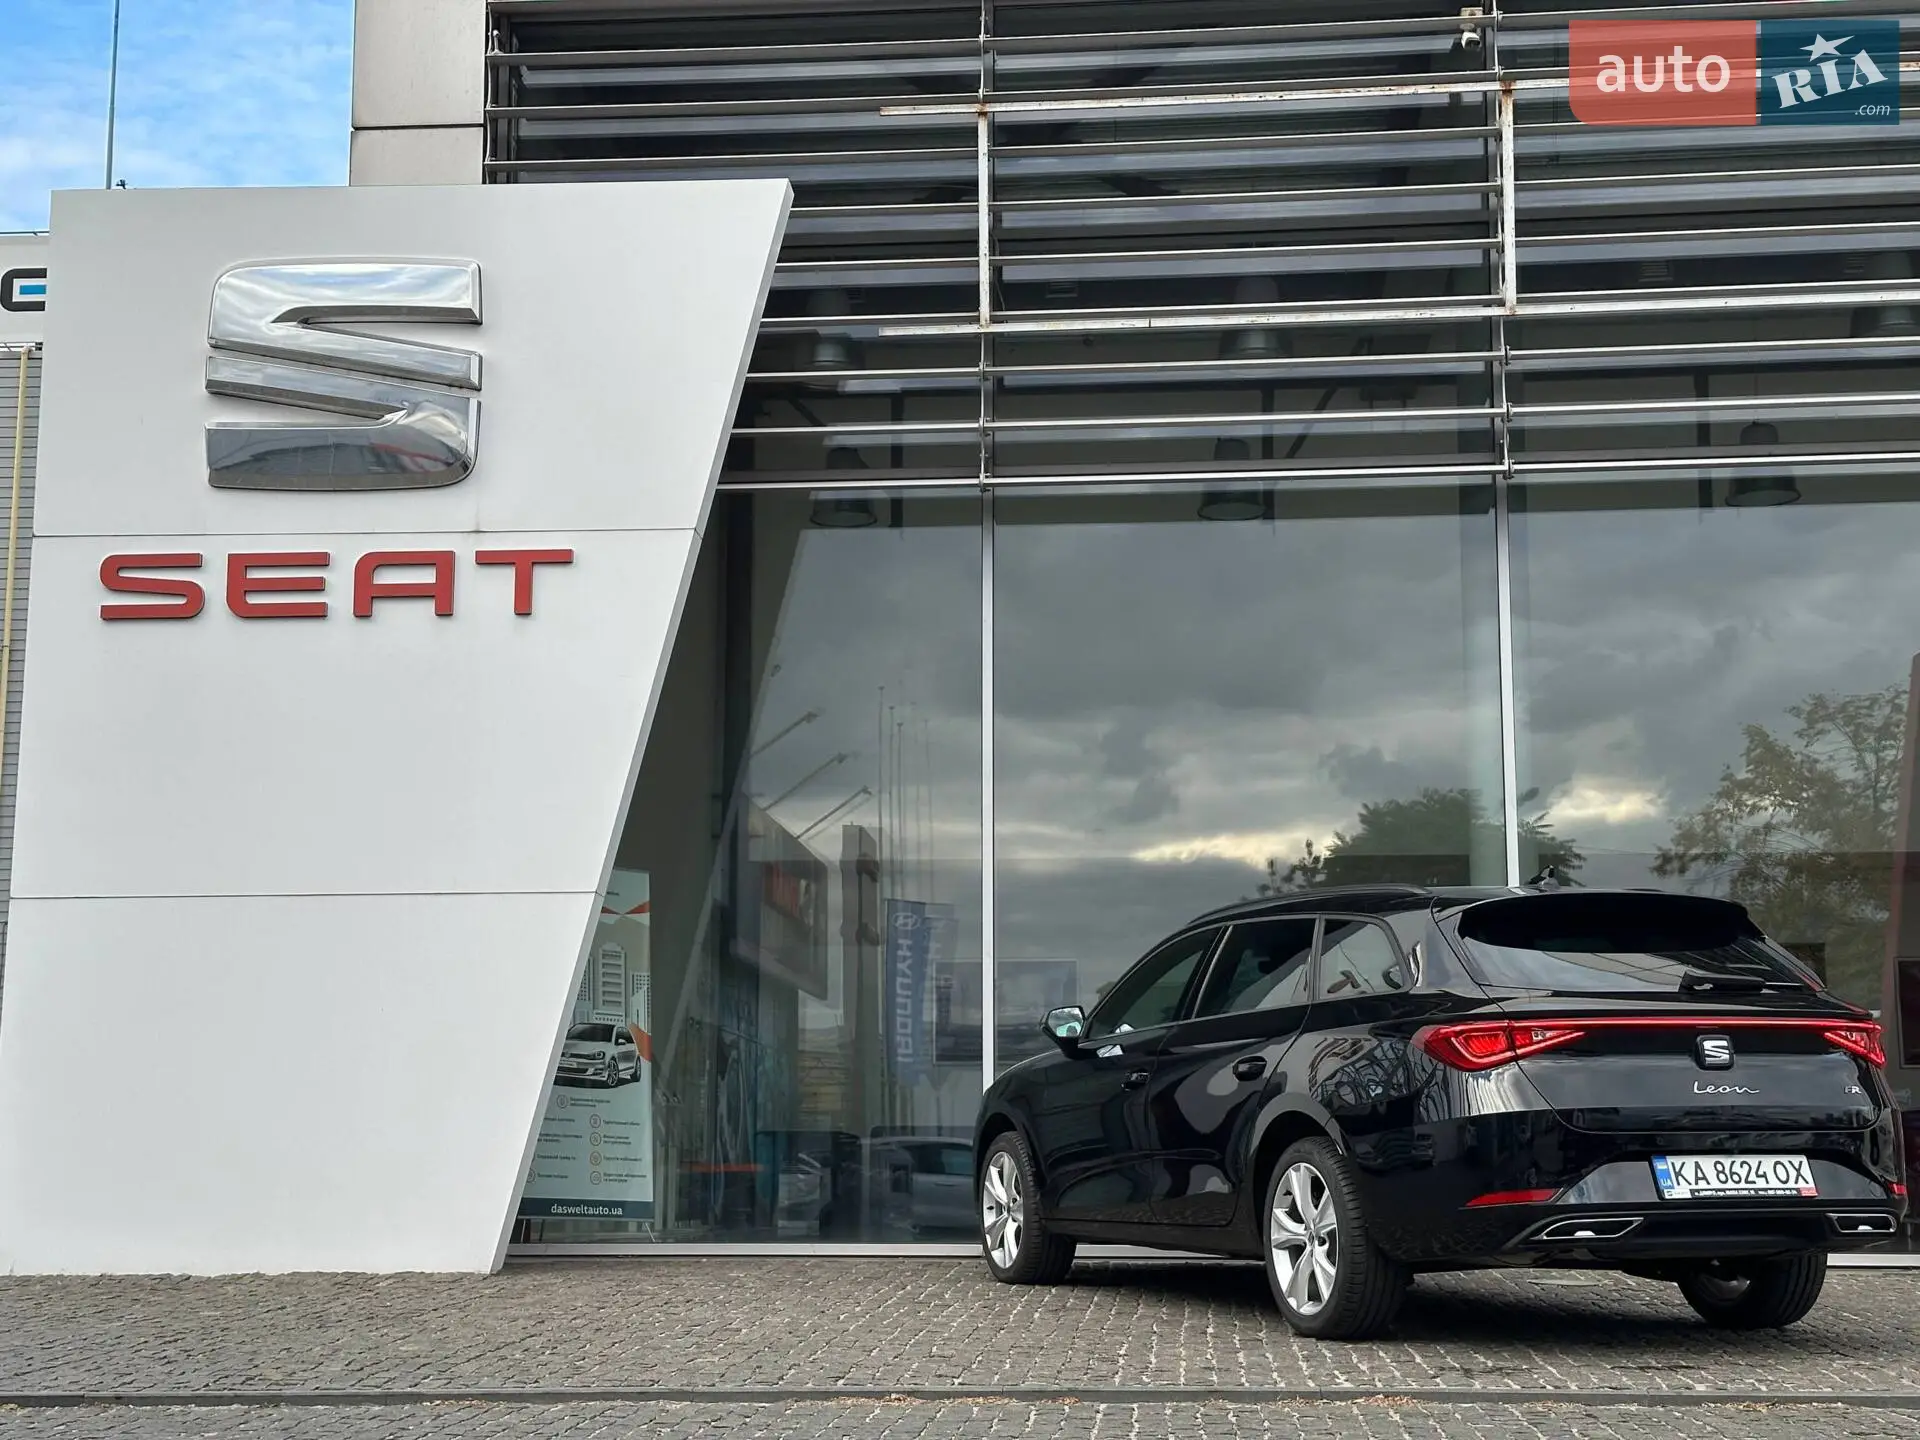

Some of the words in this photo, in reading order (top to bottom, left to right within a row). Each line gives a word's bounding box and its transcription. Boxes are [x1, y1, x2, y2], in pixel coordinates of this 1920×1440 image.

[100, 548, 574, 620] SEAT
[896, 938, 915, 1063] HYUNDAI
[1693, 1081, 1760, 1095] Leon
[1844, 1085, 1862, 1095] FR
[1671, 1160, 1711, 1186] KA
[1713, 1159, 1769, 1185] 8624
[1772, 1160, 1810, 1185] OX
[550, 1203, 624, 1217] dasweltauto.ua
